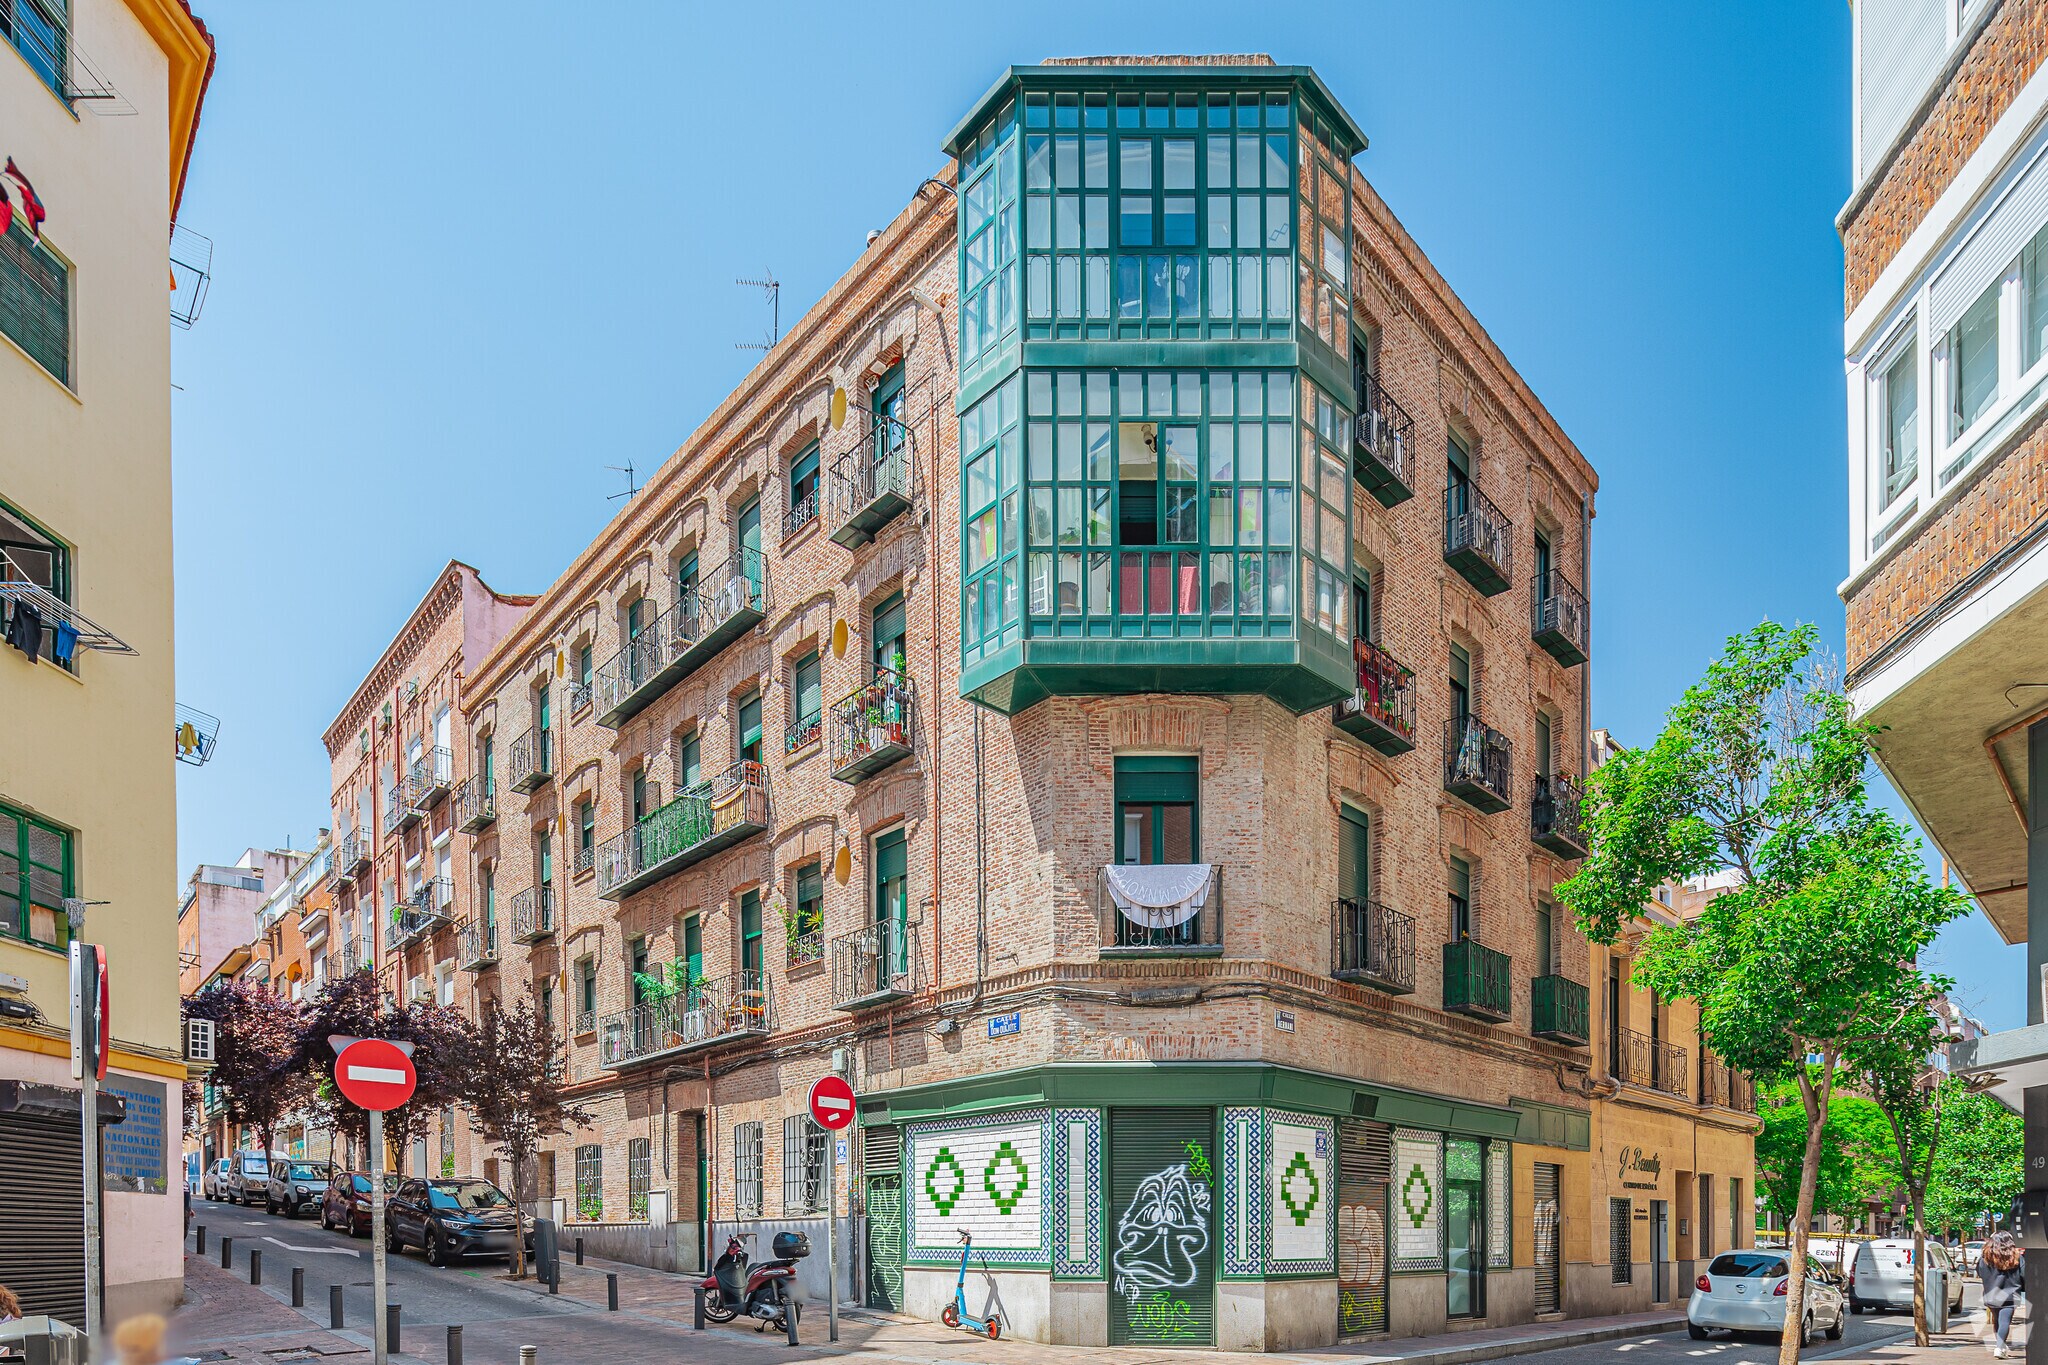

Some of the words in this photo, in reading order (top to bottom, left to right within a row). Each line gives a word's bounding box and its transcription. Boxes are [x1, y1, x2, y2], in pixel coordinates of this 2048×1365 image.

[139, 1103, 161, 1115] SECOS
[105, 1132, 161, 1147] NACIONALES
[2031, 1156, 2046, 1169] 49
[1815, 1249, 1846, 1258] EZENTS
